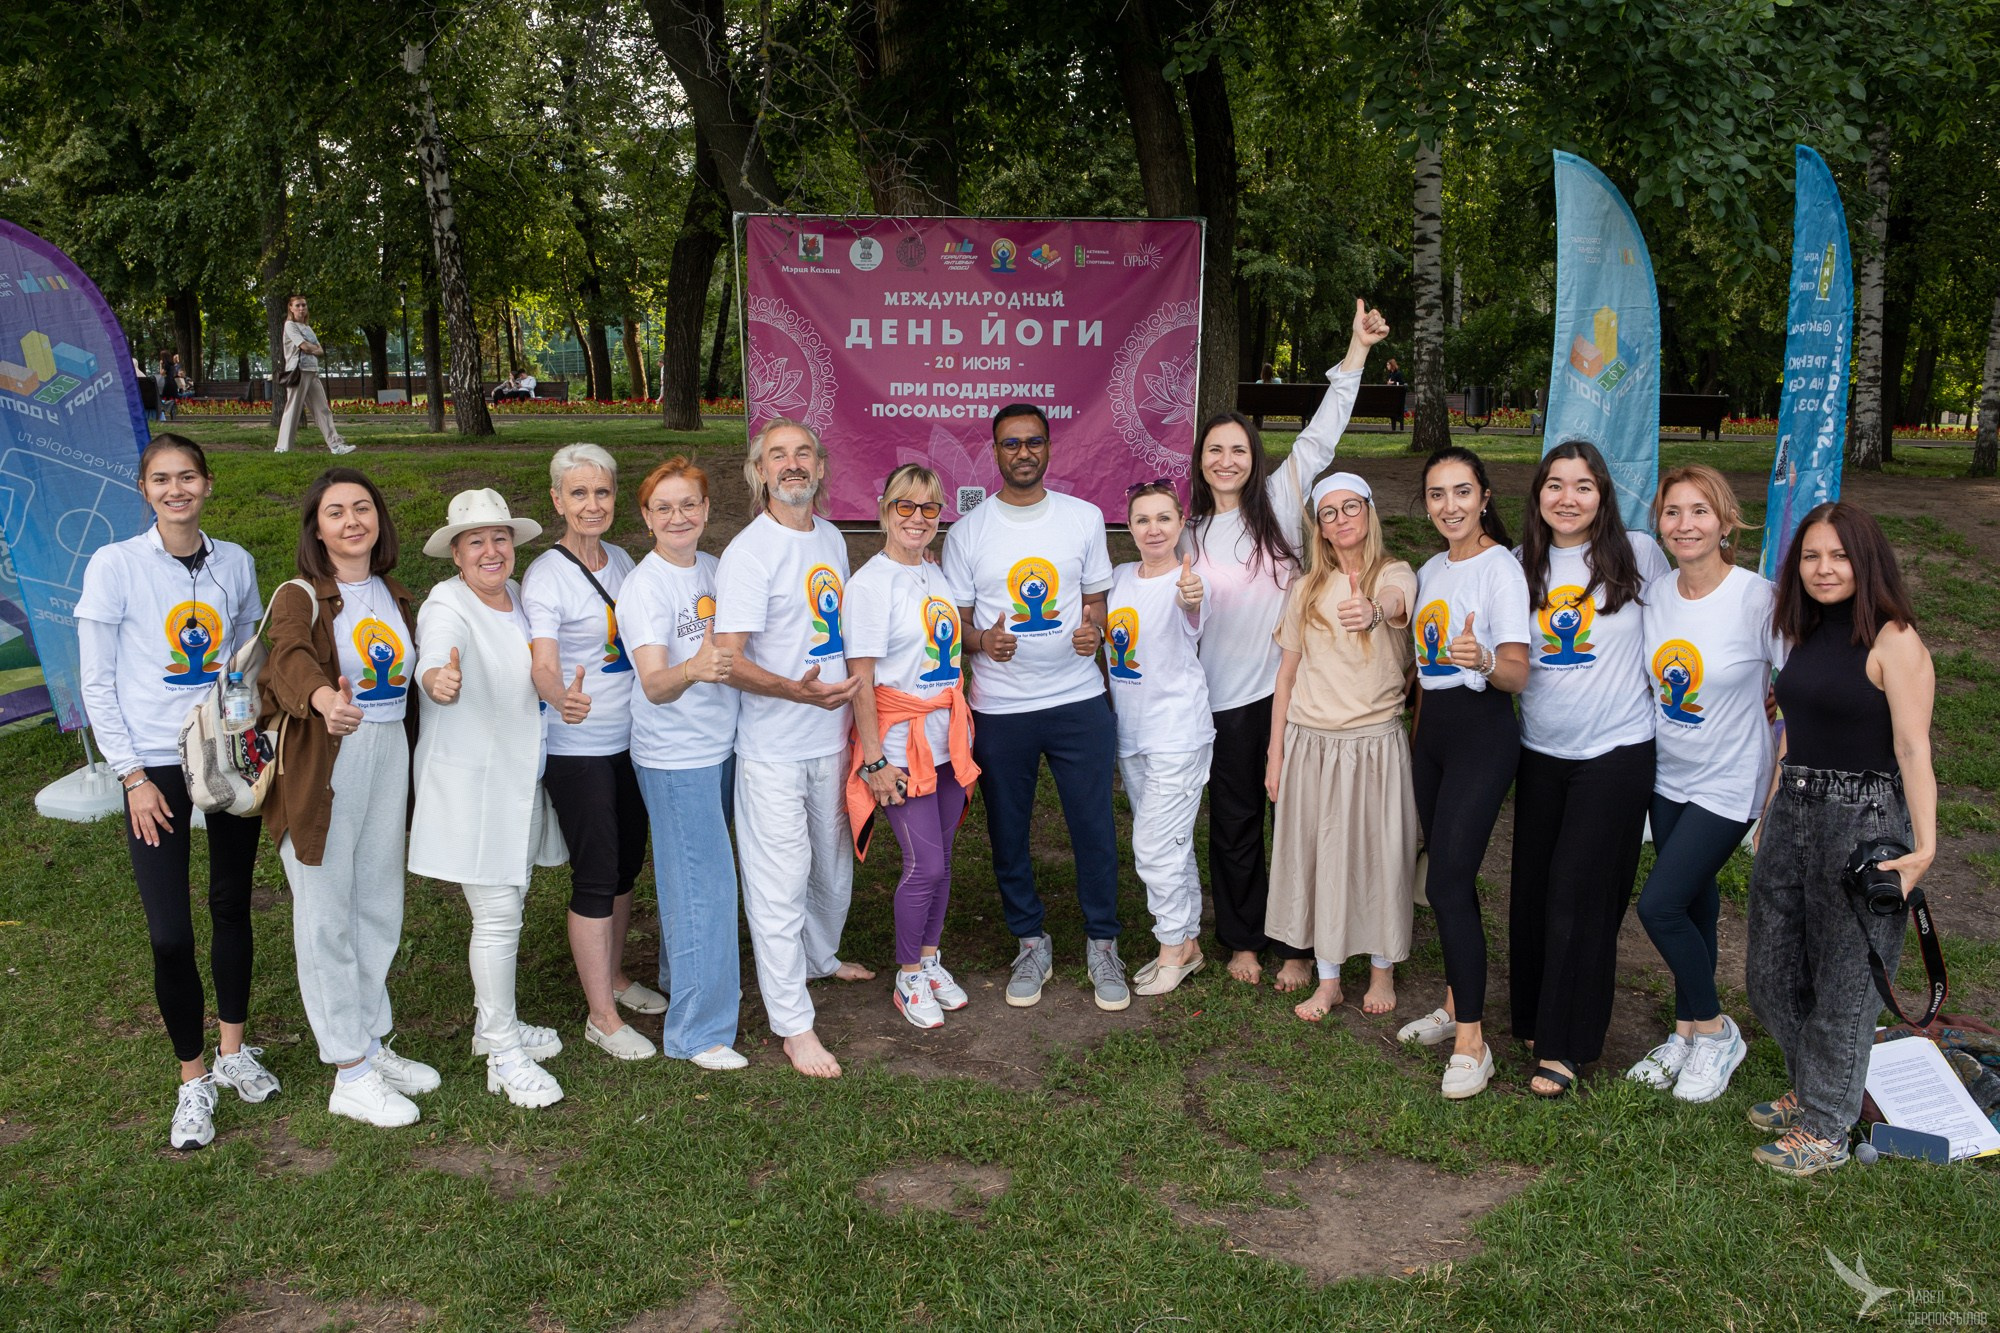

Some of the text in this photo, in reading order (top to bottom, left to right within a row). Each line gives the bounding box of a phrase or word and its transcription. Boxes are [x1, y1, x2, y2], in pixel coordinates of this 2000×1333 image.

[1123, 254, 1150, 267] СУРЬЯ
[781, 266, 840, 274] Мэрия Казани
[884, 290, 1065, 310] МЕЖДУНАРОДНЫЙ
[845, 312, 1103, 349] ДЕНЬ ЙОГИ
[934, 356, 955, 369] 20
[962, 356, 1011, 370] ИЮНЯ
[889, 382, 1055, 399] ПРИ ПОДДЕРЖКЕ
[871, 403, 1002, 419] ПОСОЛЬСТВА
[804, 657, 820, 665] Yoga
[1917, 907, 1930, 935] Canon
[1930, 982, 1944, 1013] Canon
